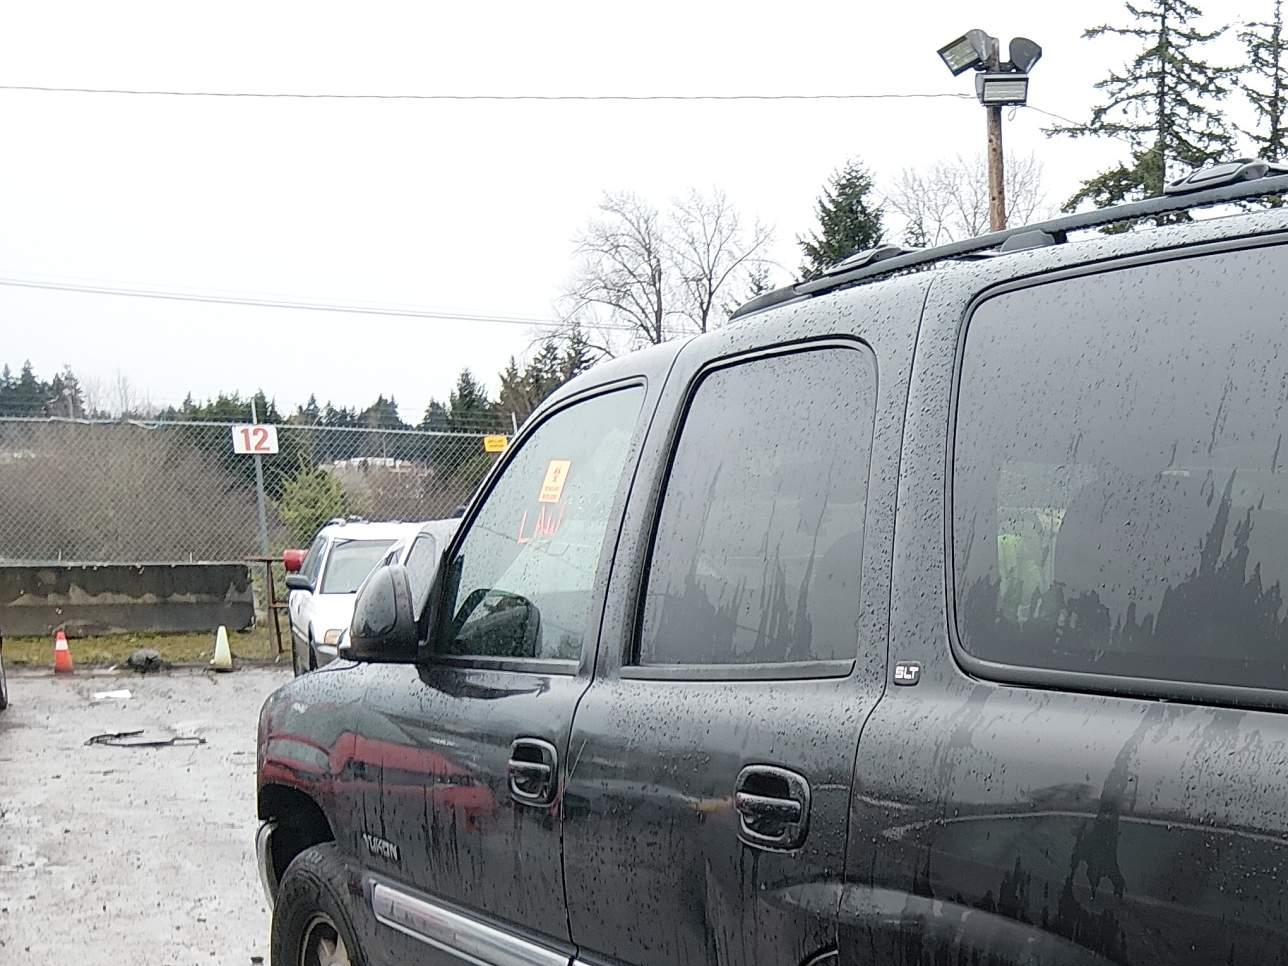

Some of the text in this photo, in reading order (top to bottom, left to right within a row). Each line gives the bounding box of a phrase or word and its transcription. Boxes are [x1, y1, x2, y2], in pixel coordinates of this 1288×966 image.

[240, 428, 271, 451] 12
[895, 665, 919, 680] SLT
[362, 832, 399, 861] YUKON
